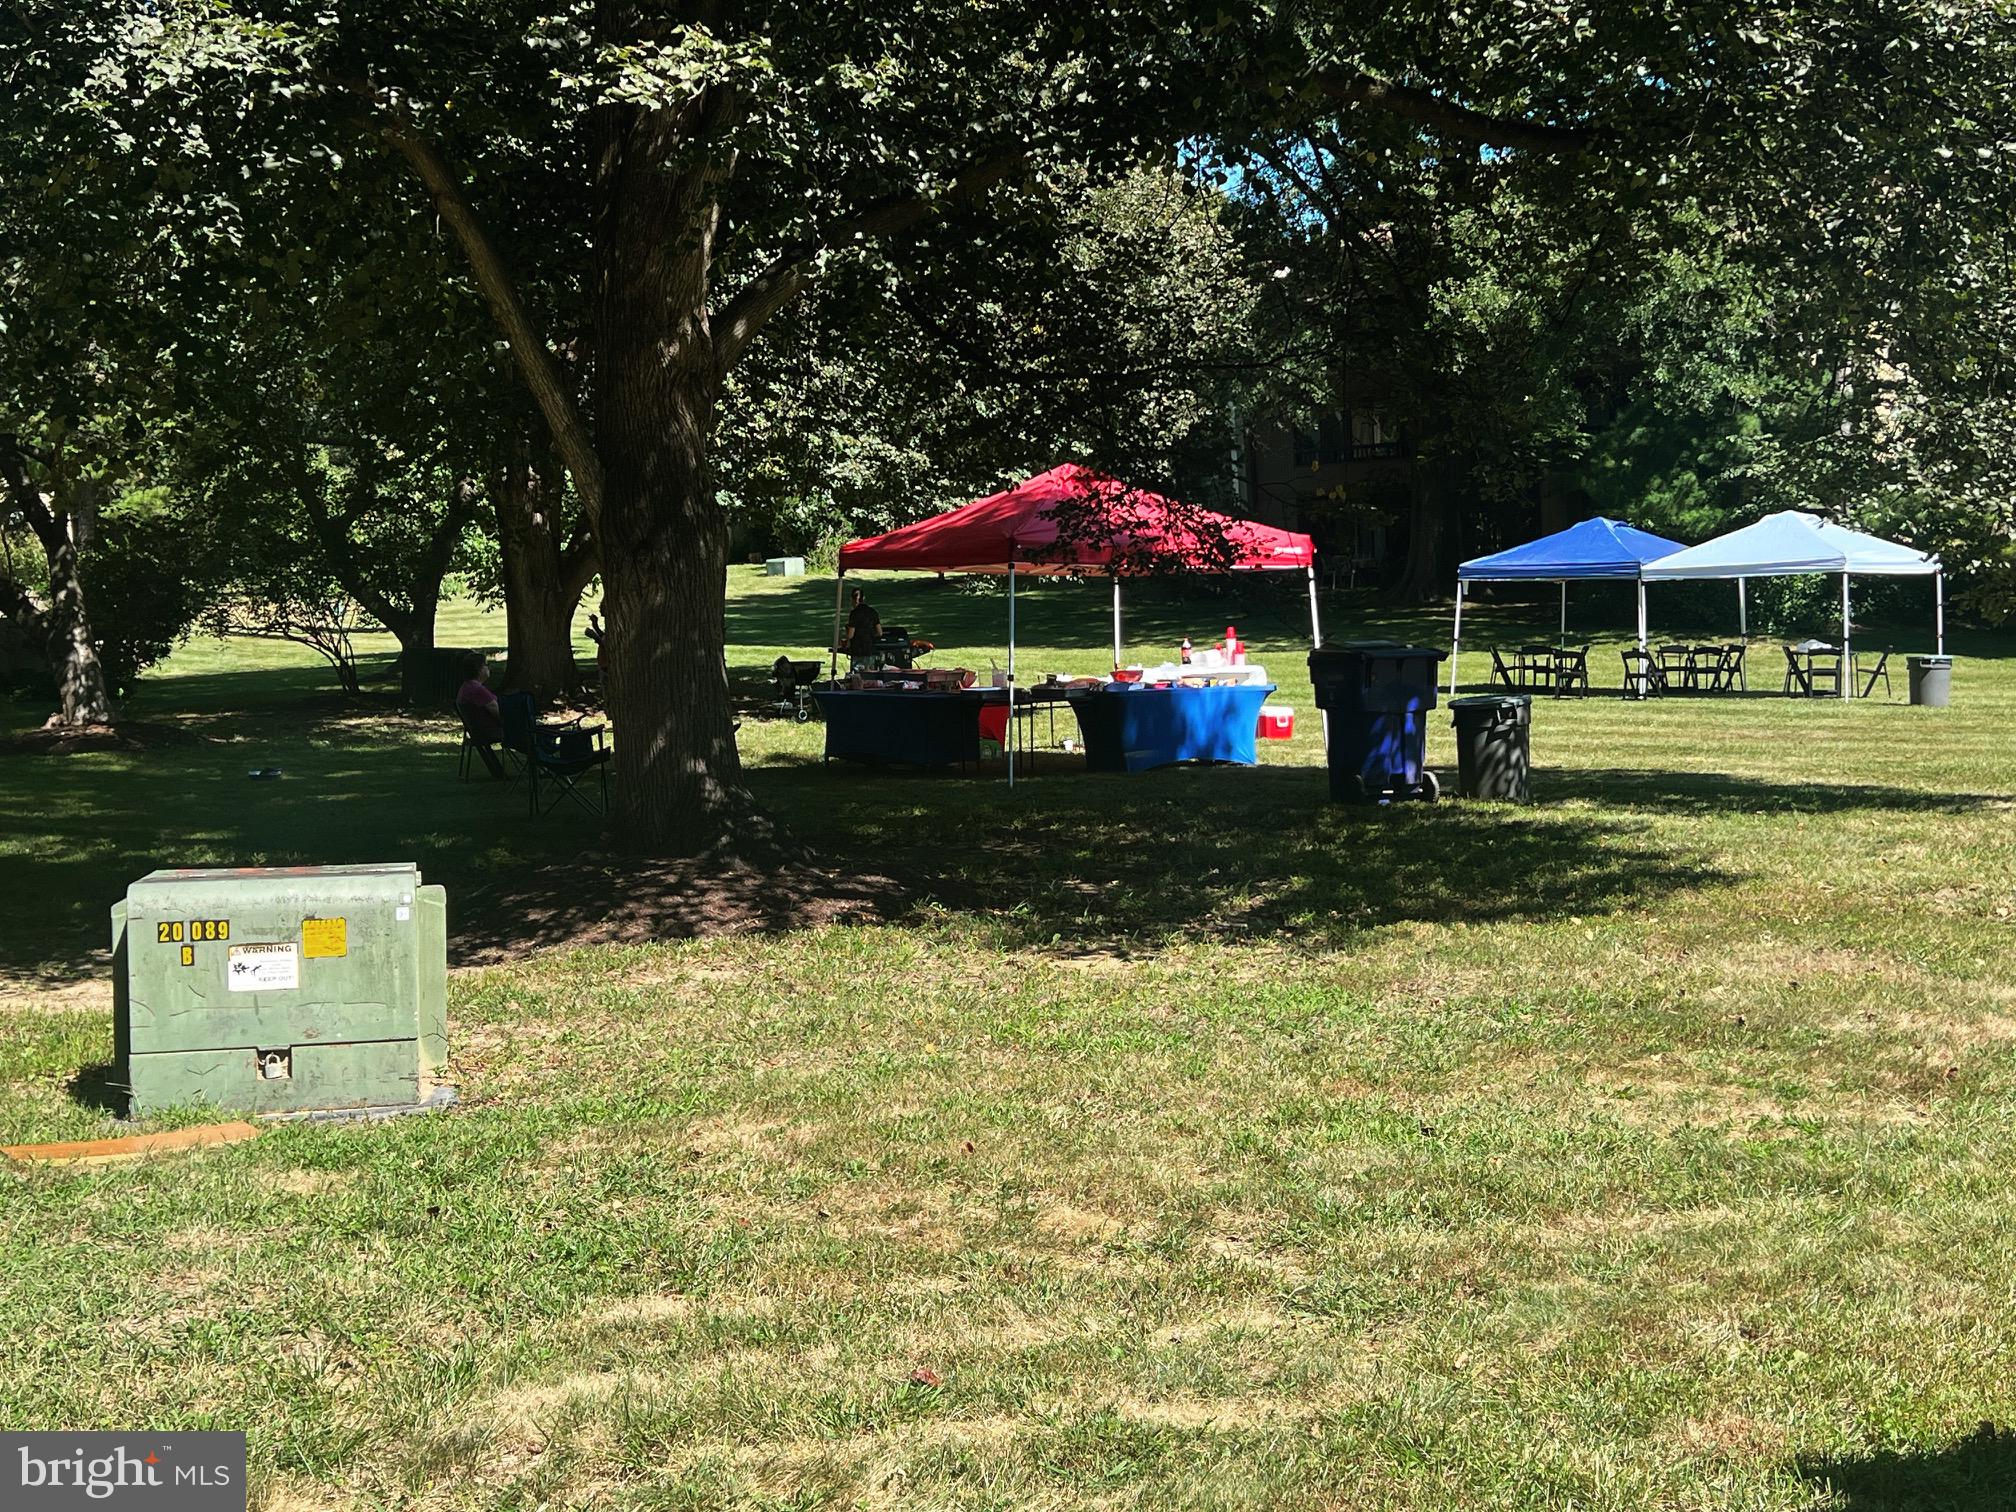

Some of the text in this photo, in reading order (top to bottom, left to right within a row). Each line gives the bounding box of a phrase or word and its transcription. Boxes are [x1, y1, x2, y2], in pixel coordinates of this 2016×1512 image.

[159, 921, 228, 942] 20 089
[182, 946, 193, 966] B
[242, 944, 292, 954] WARNING
